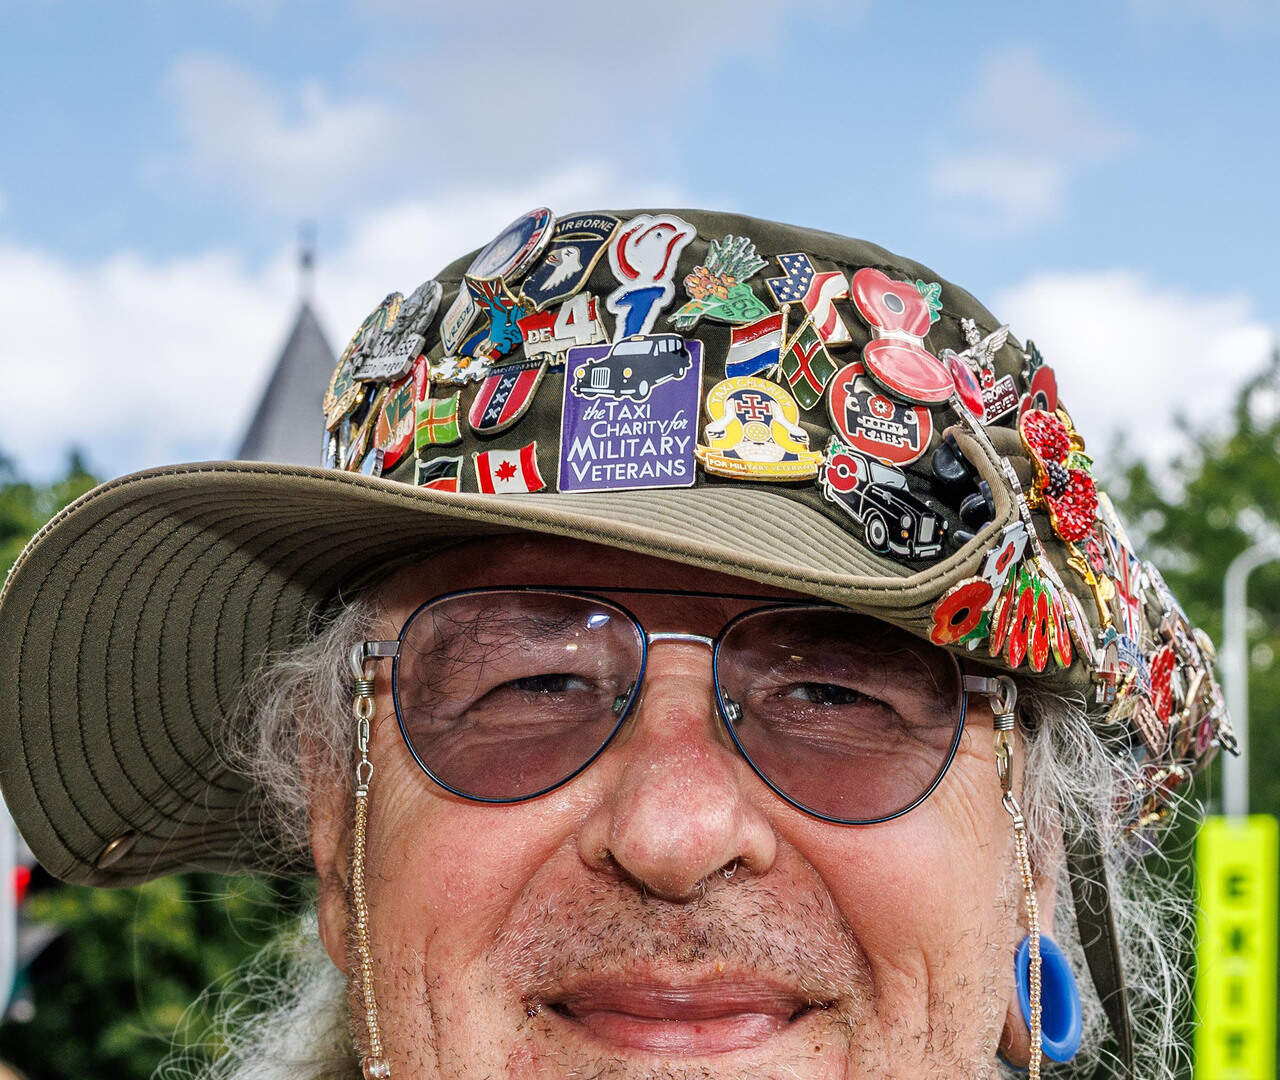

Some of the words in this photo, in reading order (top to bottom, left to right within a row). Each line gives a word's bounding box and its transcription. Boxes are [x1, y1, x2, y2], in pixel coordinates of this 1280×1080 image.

[527, 327, 552, 344] DE
[554, 291, 597, 345] 4
[712, 383, 734, 403] TAXI
[736, 378, 792, 407] CHARITY
[583, 399, 606, 421] the
[605, 402, 651, 421] TAXI
[985, 394, 1014, 419] OREVER
[590, 420, 669, 438] CHARITY
[663, 410, 688, 436] for
[567, 436, 691, 462] MILITARY
[571, 459, 686, 483] VETERANS
[709, 459, 728, 468] FOR
[730, 460, 769, 471] MILITARY
